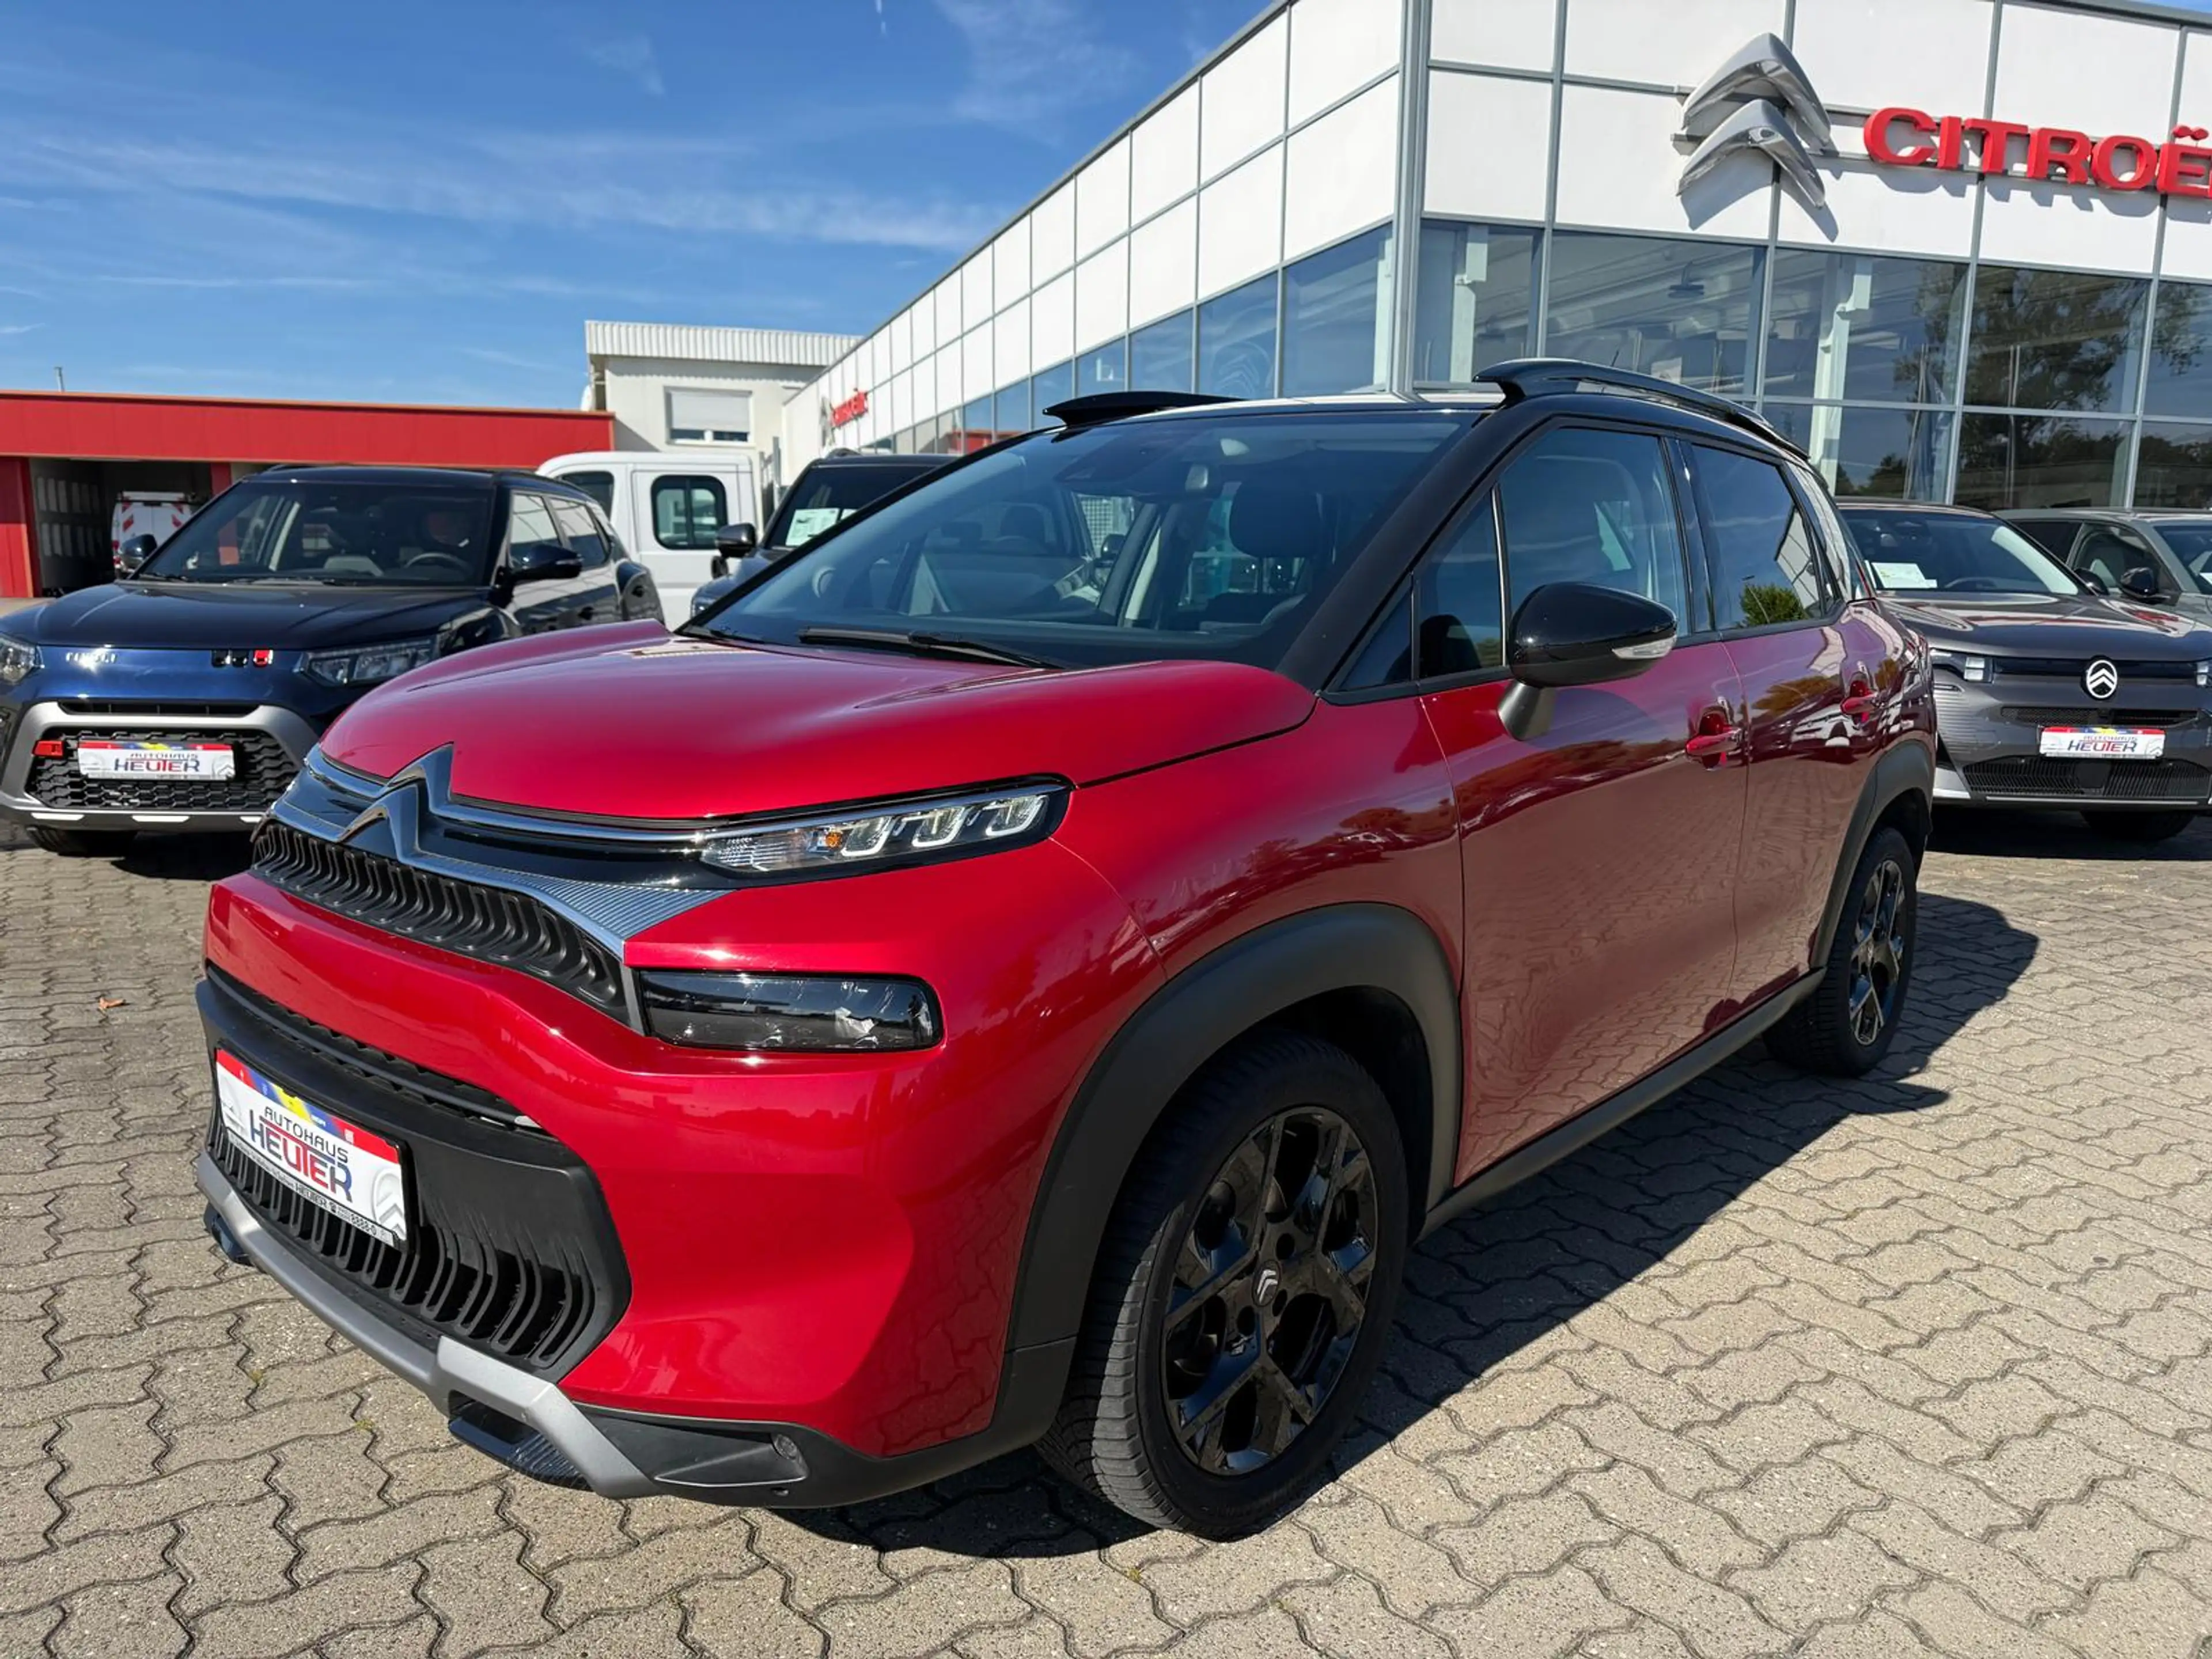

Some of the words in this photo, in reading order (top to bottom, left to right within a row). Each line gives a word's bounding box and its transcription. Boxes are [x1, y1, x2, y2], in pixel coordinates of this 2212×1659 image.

[1864, 107, 2212, 198] CITROË
[114, 758, 200, 772] HEUTER
[2067, 740, 2138, 752] HEUTER
[249, 1109, 353, 1203] HEUTER
[264, 1105, 349, 1164] AUTOHAUS
